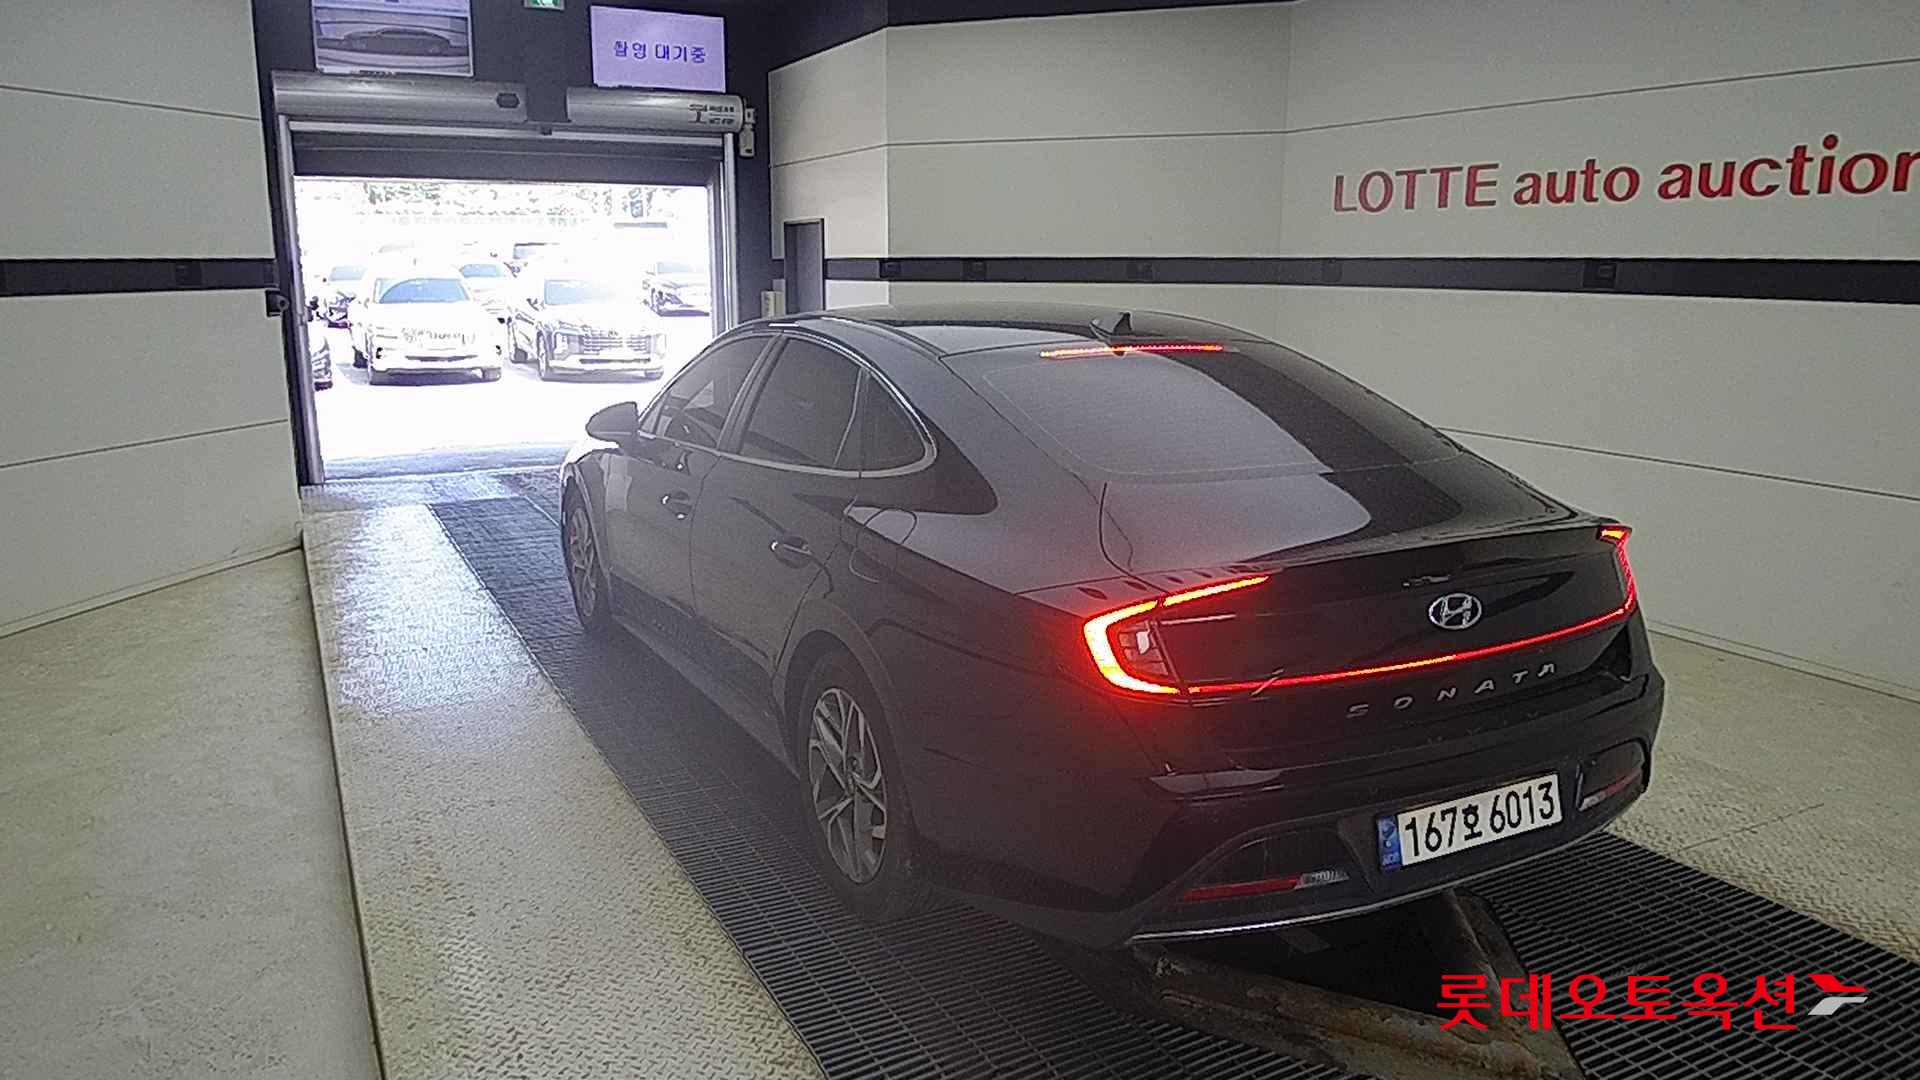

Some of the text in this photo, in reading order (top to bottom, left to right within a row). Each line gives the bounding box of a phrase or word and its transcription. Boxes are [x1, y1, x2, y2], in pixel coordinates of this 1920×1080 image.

[655, 44, 706, 64] 대기중
[1334, 163, 1499, 212] LOTTE
[1514, 158, 1640, 205] auto
[1346, 663, 1555, 718] SONATA
